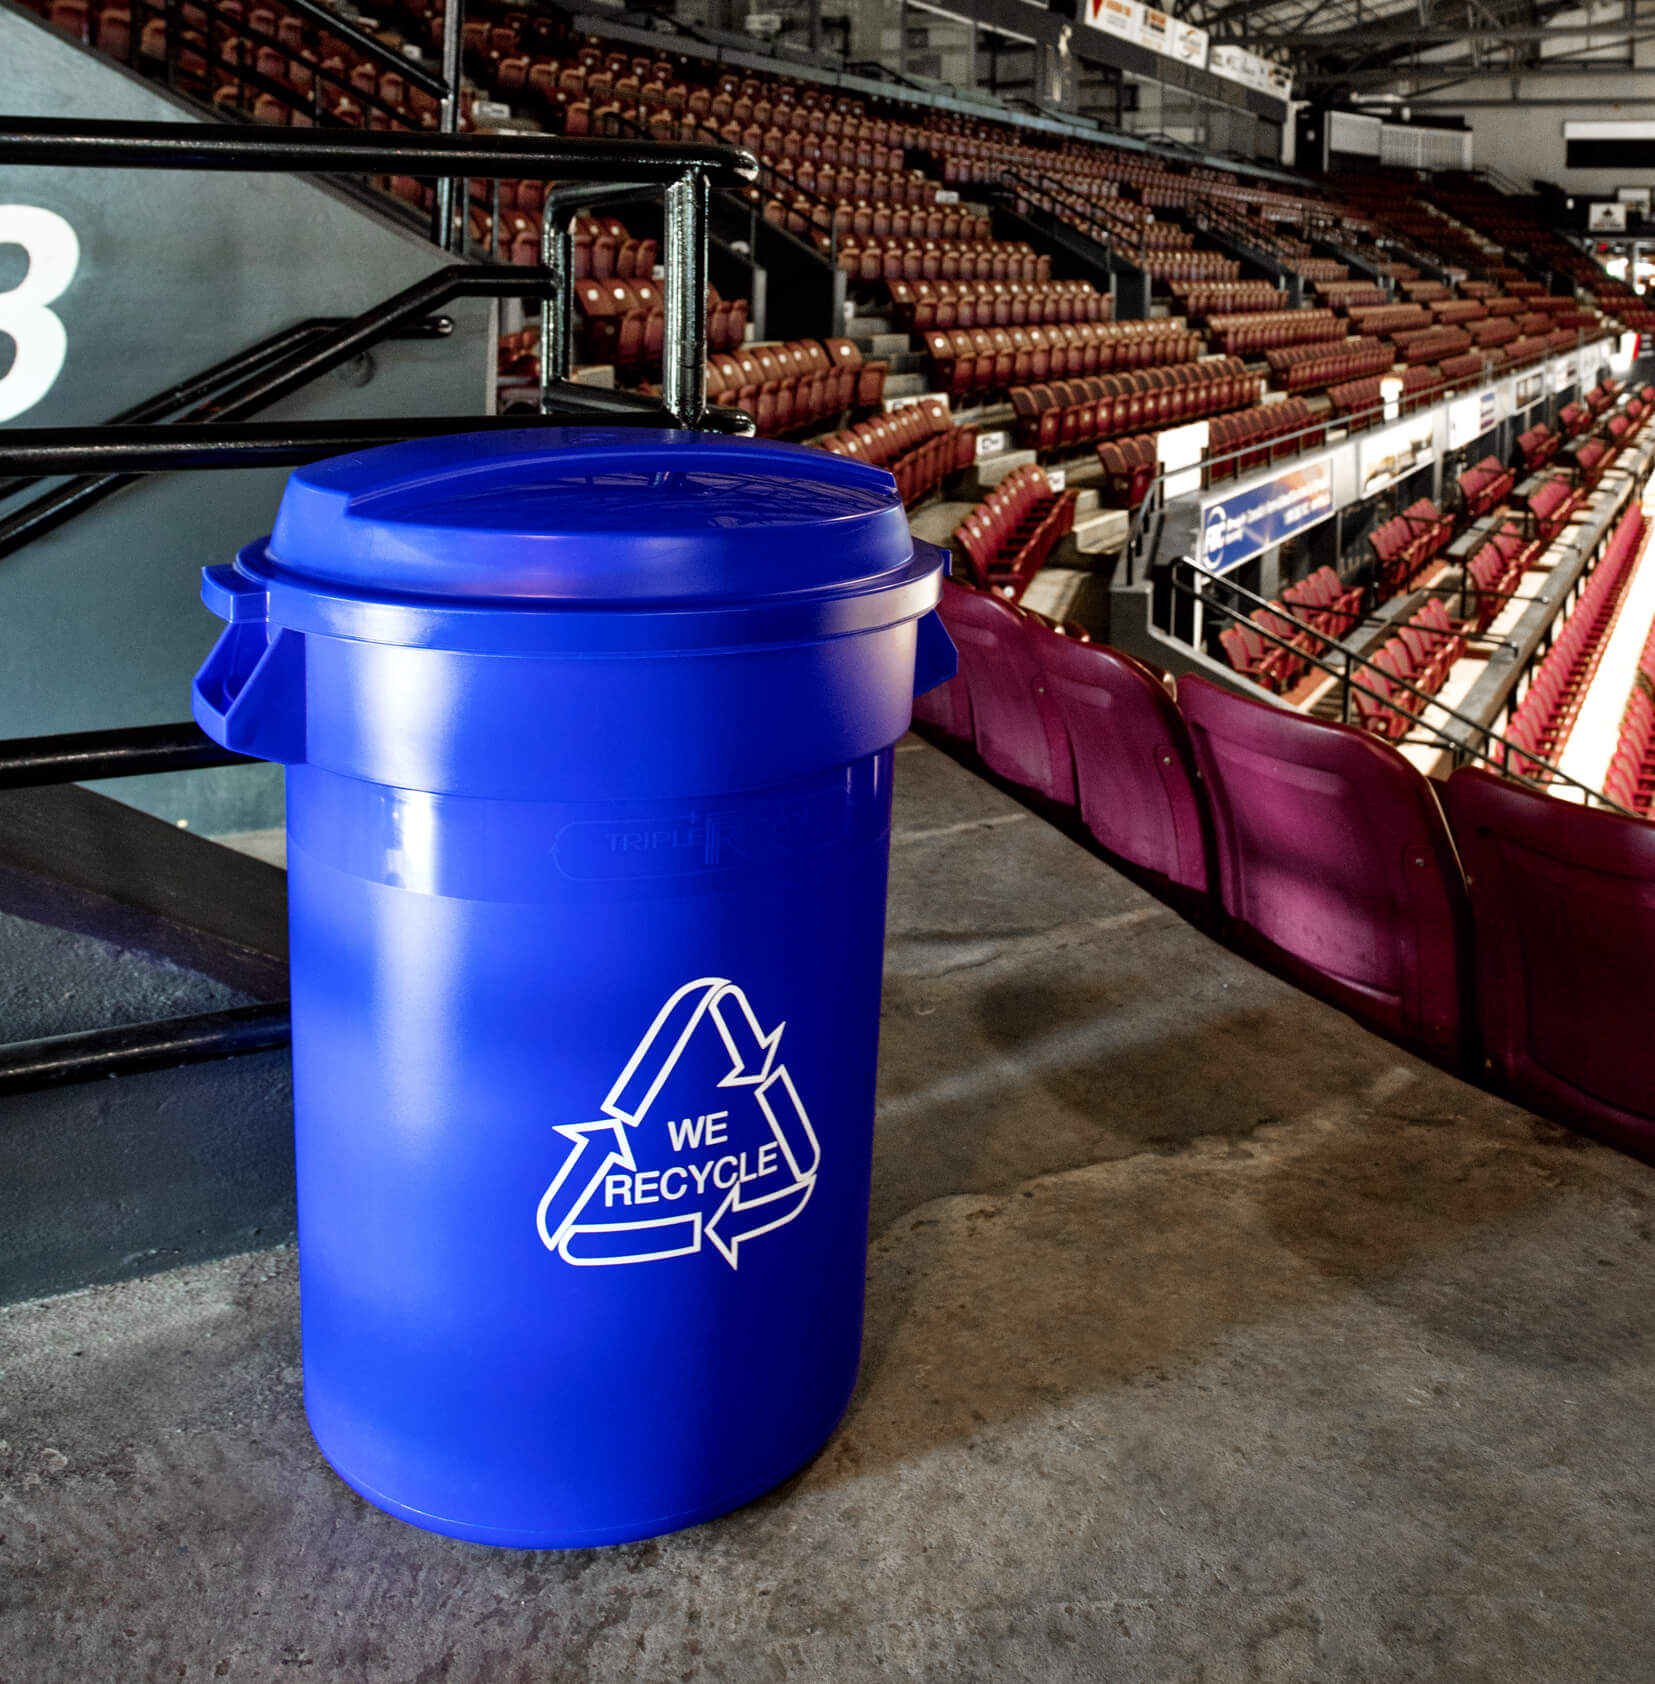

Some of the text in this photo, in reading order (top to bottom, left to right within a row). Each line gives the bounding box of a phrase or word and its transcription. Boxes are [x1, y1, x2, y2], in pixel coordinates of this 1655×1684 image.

[604, 828, 704, 853] TRIPLE
[667, 1110, 729, 1152] WE
[604, 1141, 779, 1207] RECYCLE
